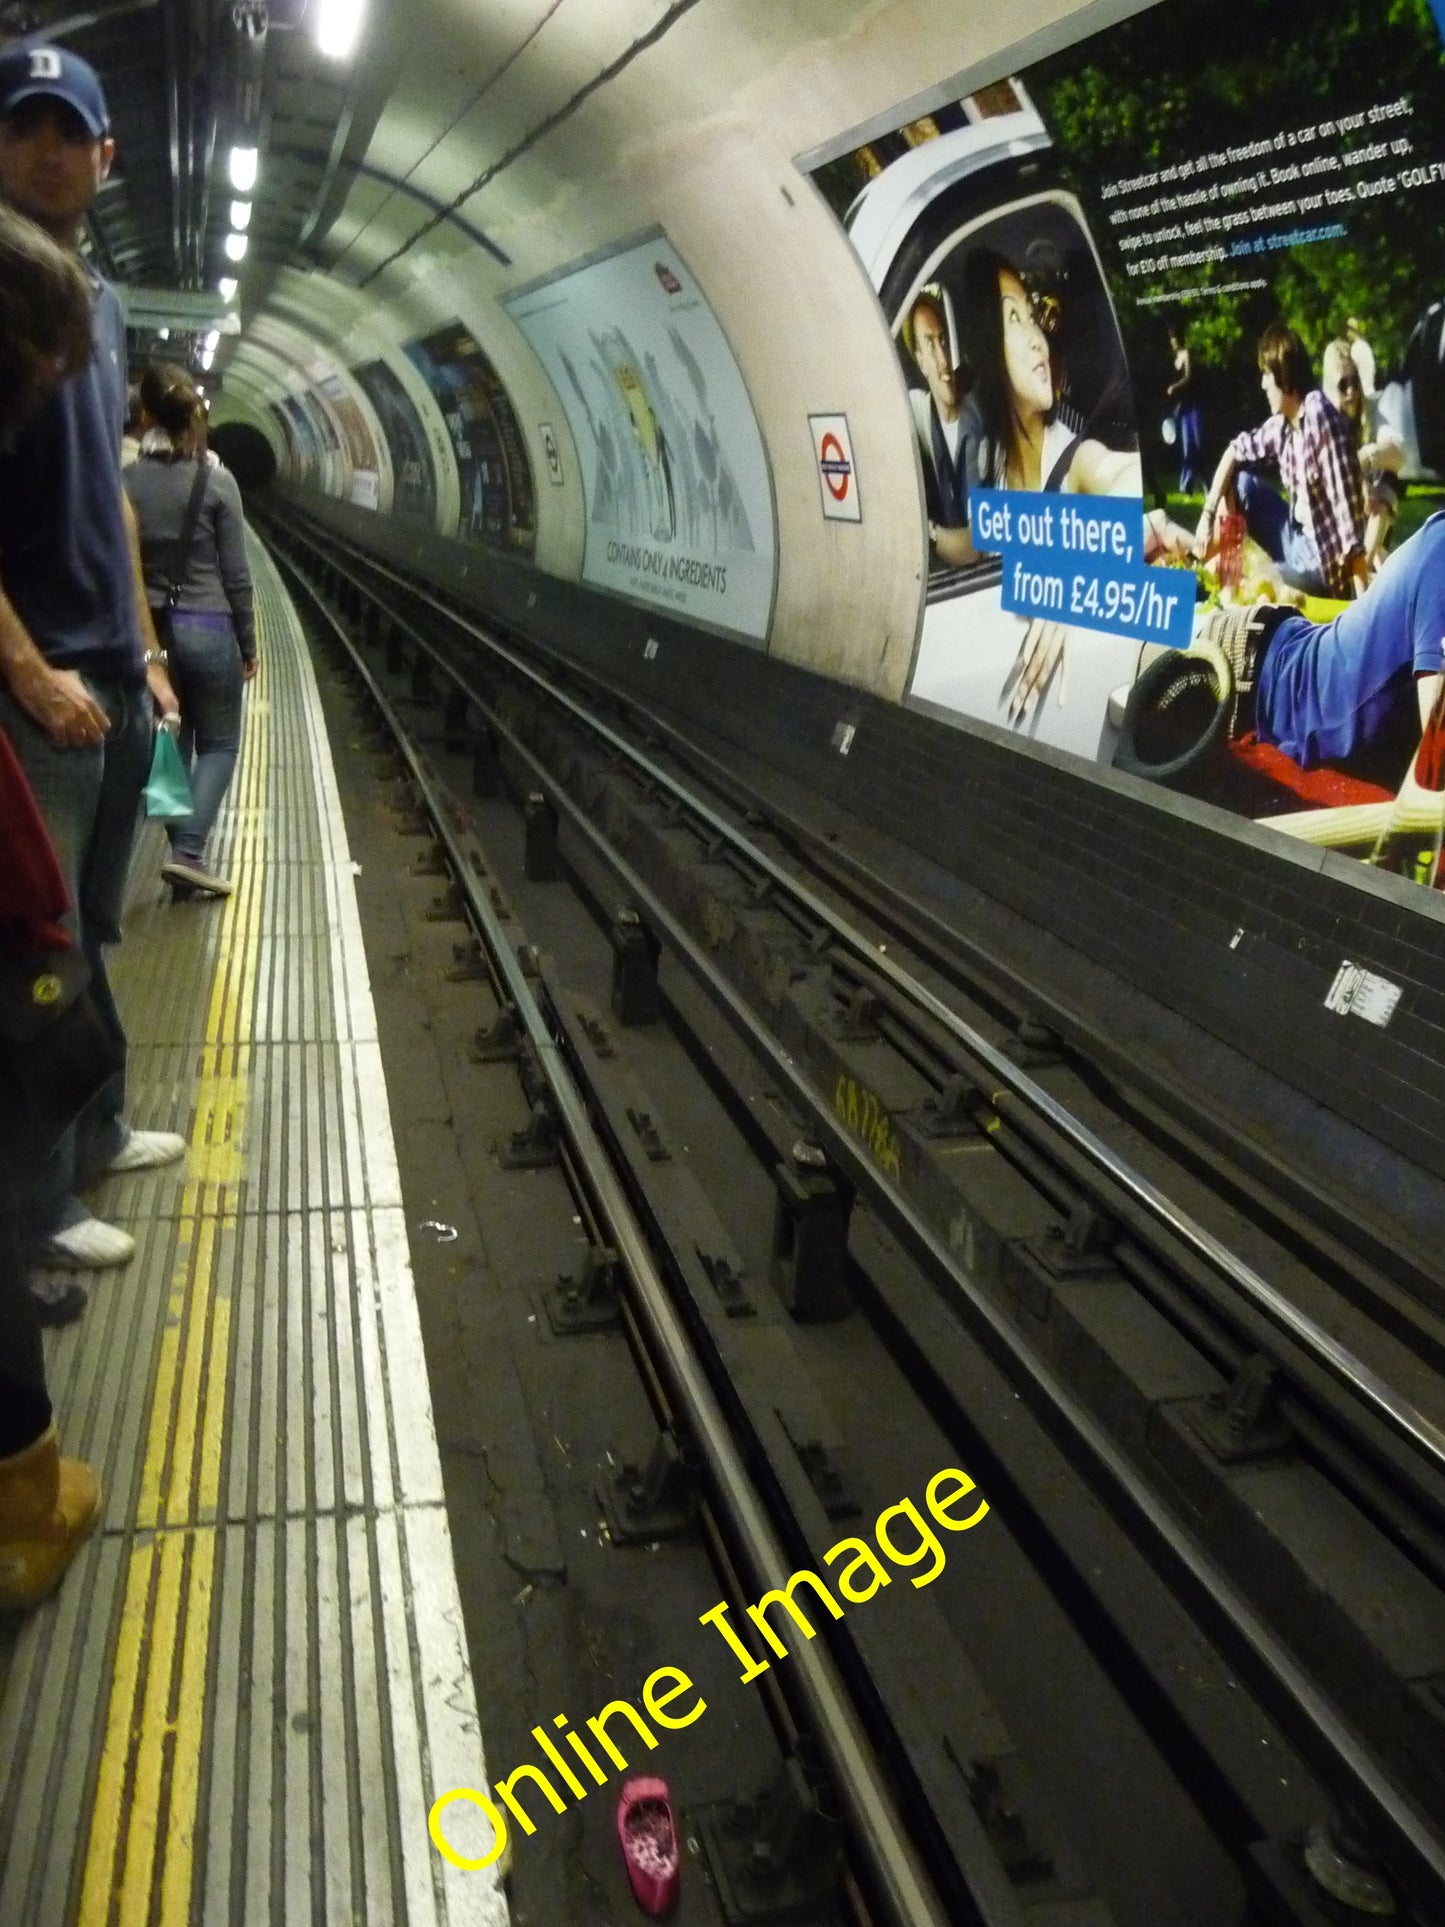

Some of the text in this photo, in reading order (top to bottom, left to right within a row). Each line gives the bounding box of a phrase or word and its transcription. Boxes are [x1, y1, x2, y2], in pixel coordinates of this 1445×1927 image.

[29, 49, 61, 78] D
[1101, 96, 1414, 200] Join Streetcar and get all the freedom of a car on your street,
[1109, 137, 1414, 226] with none of the hassle of owning it. Book online, wander up,
[1118, 235, 1143, 251] swipe
[1142, 231, 1153, 246] to
[1153, 224, 1186, 244] unlock,
[1184, 218, 1205, 237] feel
[1203, 215, 1223, 233] the
[1221, 210, 1250, 232] grass
[1249, 199, 1297, 222] between
[1297, 193, 1324, 215] your
[1324, 186, 1357, 206] toes.
[1356, 176, 1397, 199] Quote
[1126, 261, 1140, 277] for
[1156, 254, 1169, 270] off
[1169, 244, 1229, 269] membership.
[1230, 239, 1251, 257] Join
[1253, 236, 1266, 252] at
[1267, 223, 1348, 250] streetcar.com.
[978, 501, 1133, 564] Get out there,
[607, 540, 641, 570] CONTAINS
[642, 549, 663, 575] ONLY
[662, 560, 668, 580] 4
[670, 555, 727, 594] INGREDIENTS
[1013, 561, 1178, 631] from £4.95/hr
